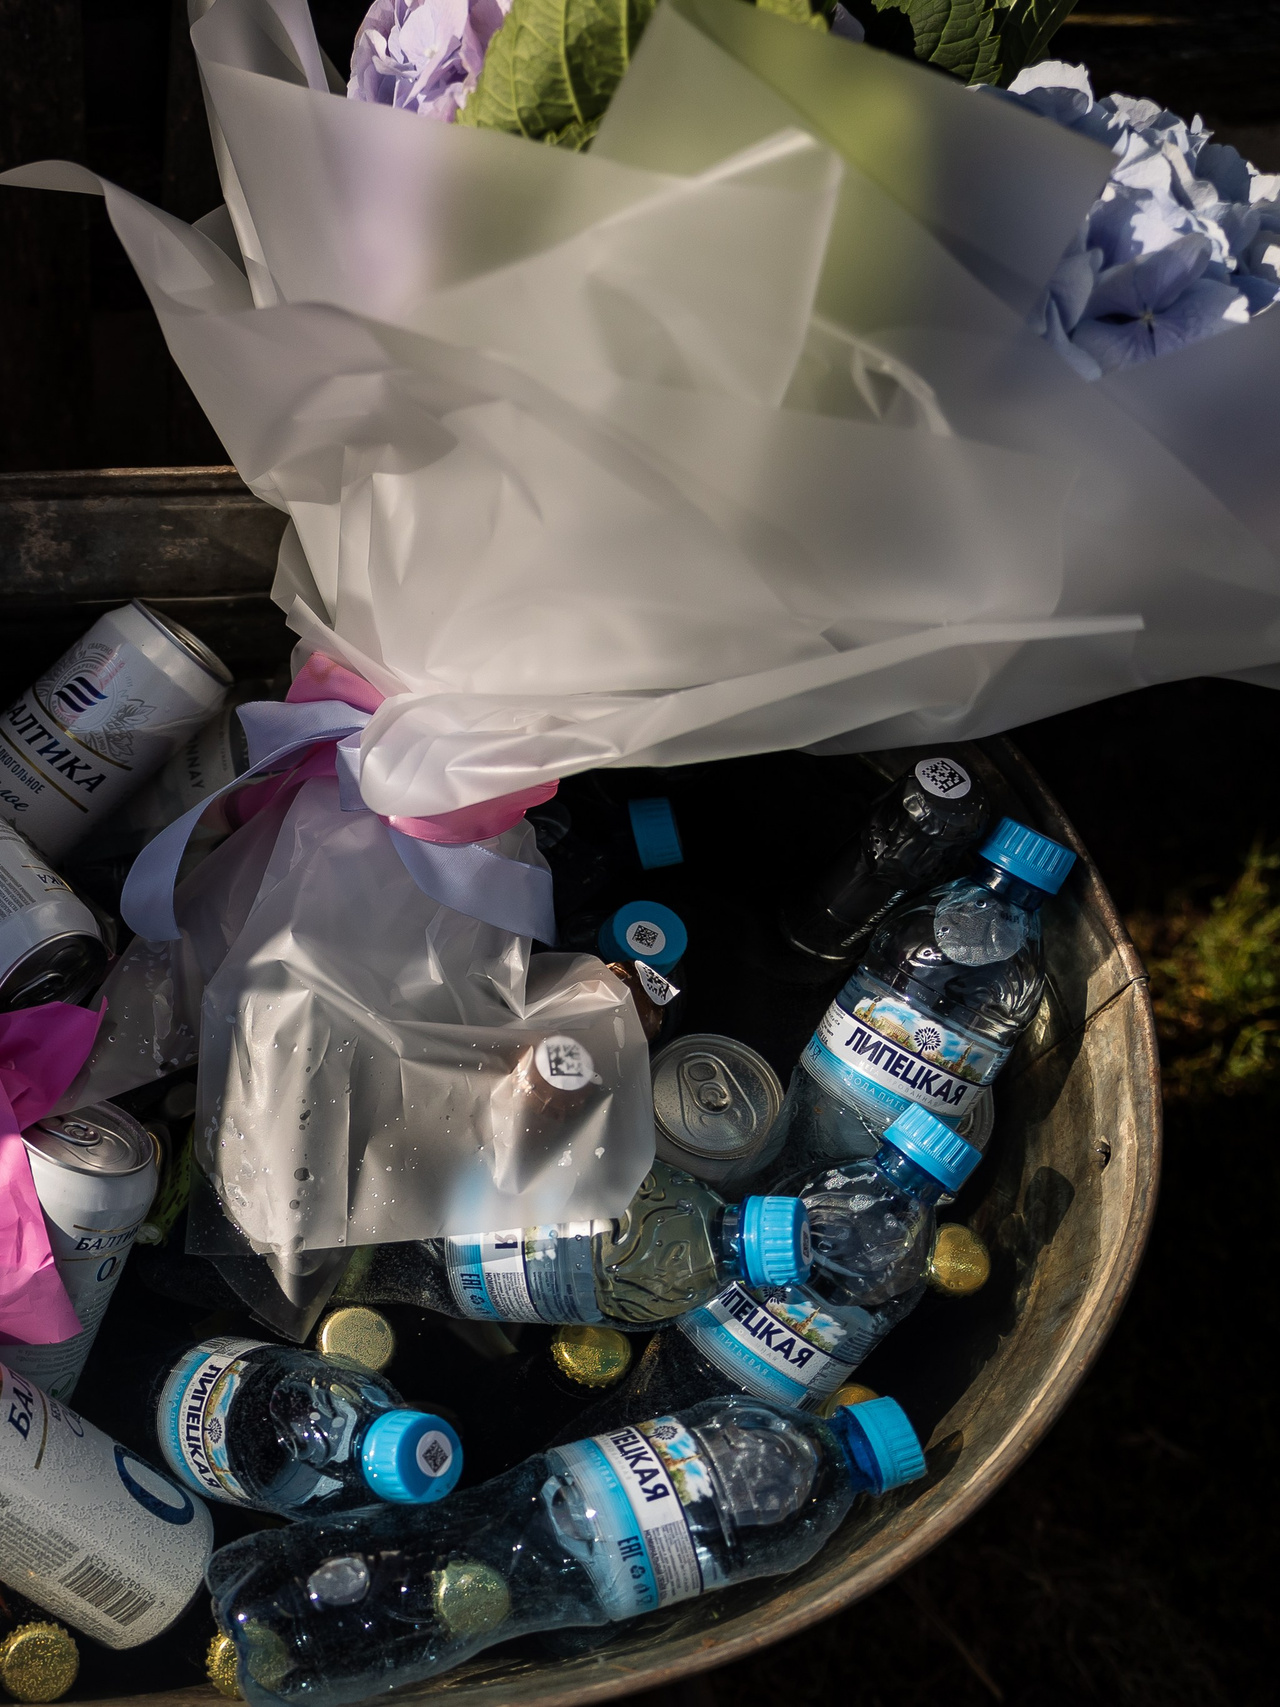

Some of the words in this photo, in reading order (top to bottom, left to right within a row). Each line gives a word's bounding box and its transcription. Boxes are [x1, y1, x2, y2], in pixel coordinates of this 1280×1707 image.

[844, 1025, 969, 1106] ЛИПЕЦКАЯ
[878, 1091, 906, 1111] ПИТЬ
[719, 1286, 816, 1369] ИПЕЦКАЯ
[185, 1364, 223, 1489] ЛИПЕЦКАЯ
